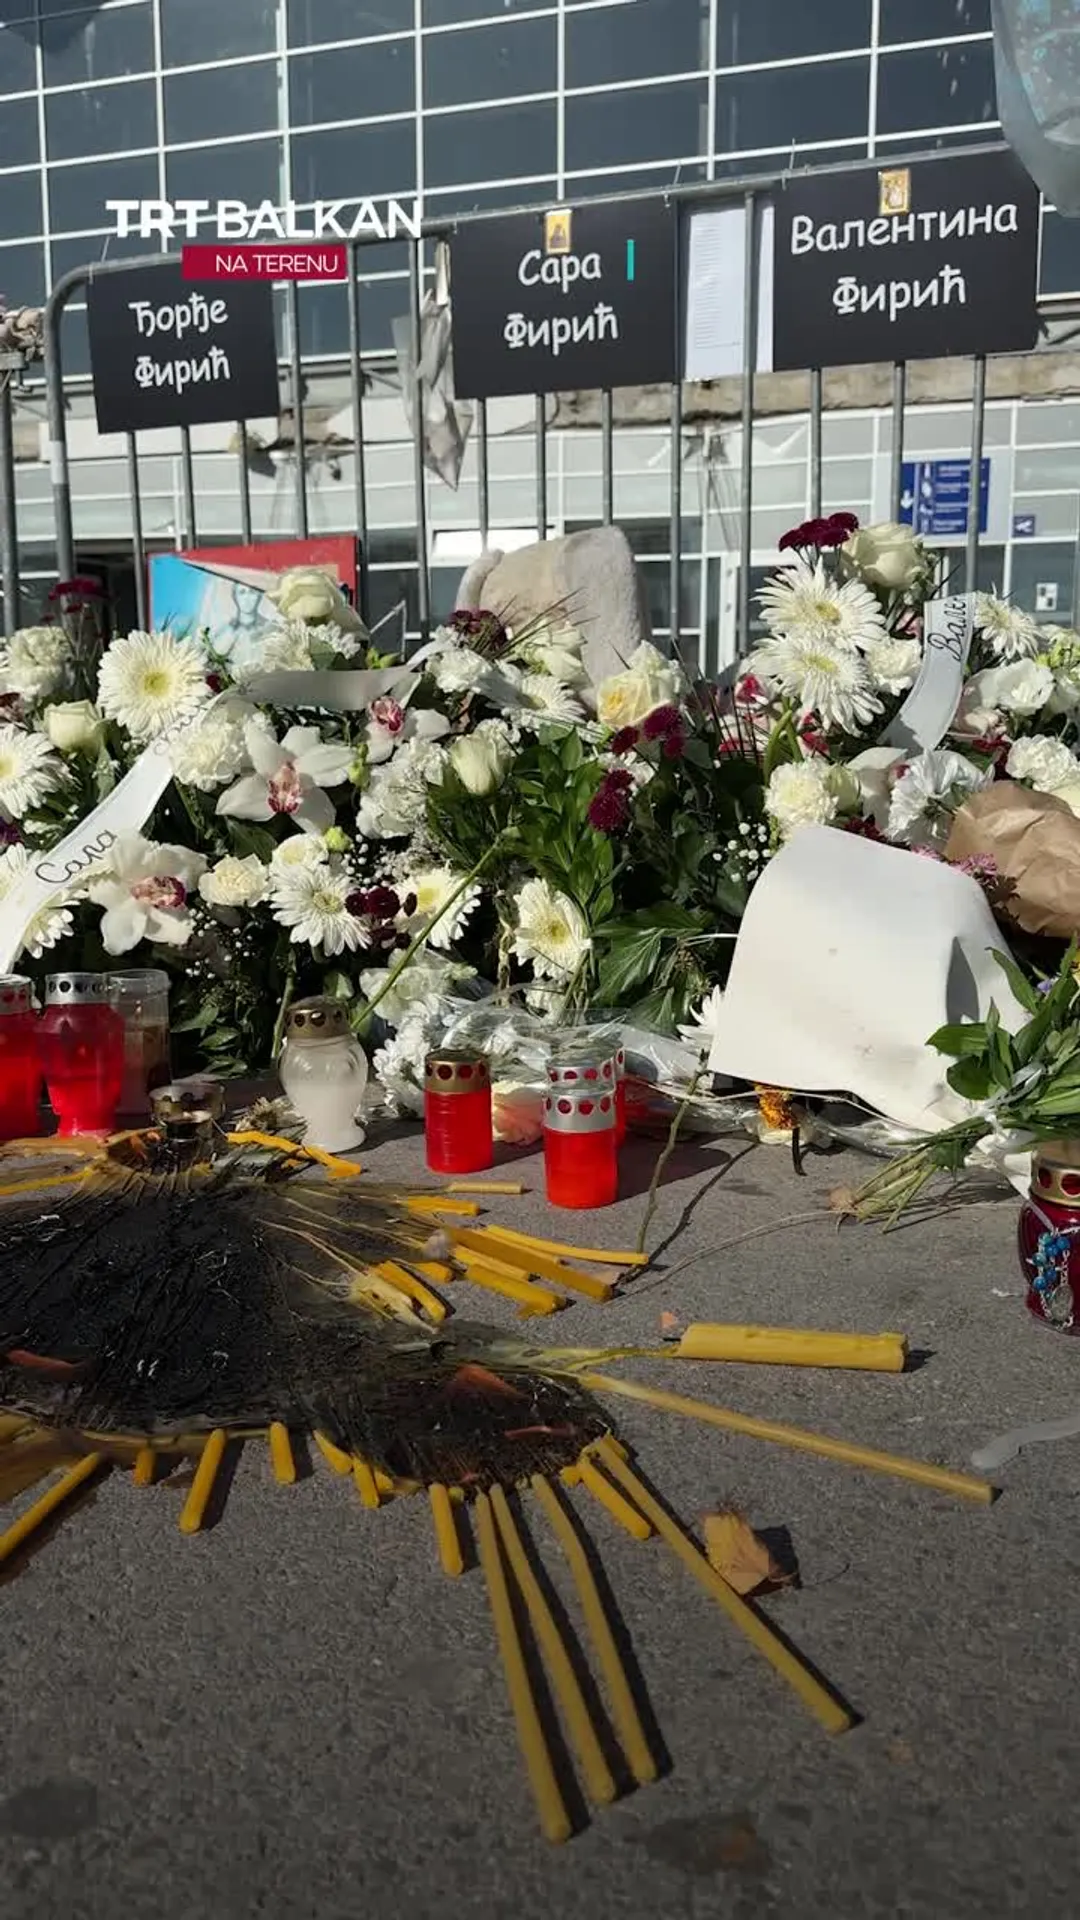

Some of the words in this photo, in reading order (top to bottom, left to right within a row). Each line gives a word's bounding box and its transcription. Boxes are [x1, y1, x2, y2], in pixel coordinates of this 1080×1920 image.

[790, 203, 1018, 255] Валентина
[518, 250, 602, 293] Сара
[832, 264, 966, 322] Фирић
[128, 291, 229, 339] Ђорђе
[503, 301, 619, 356] Фирић
[133, 345, 231, 394] Фирић
